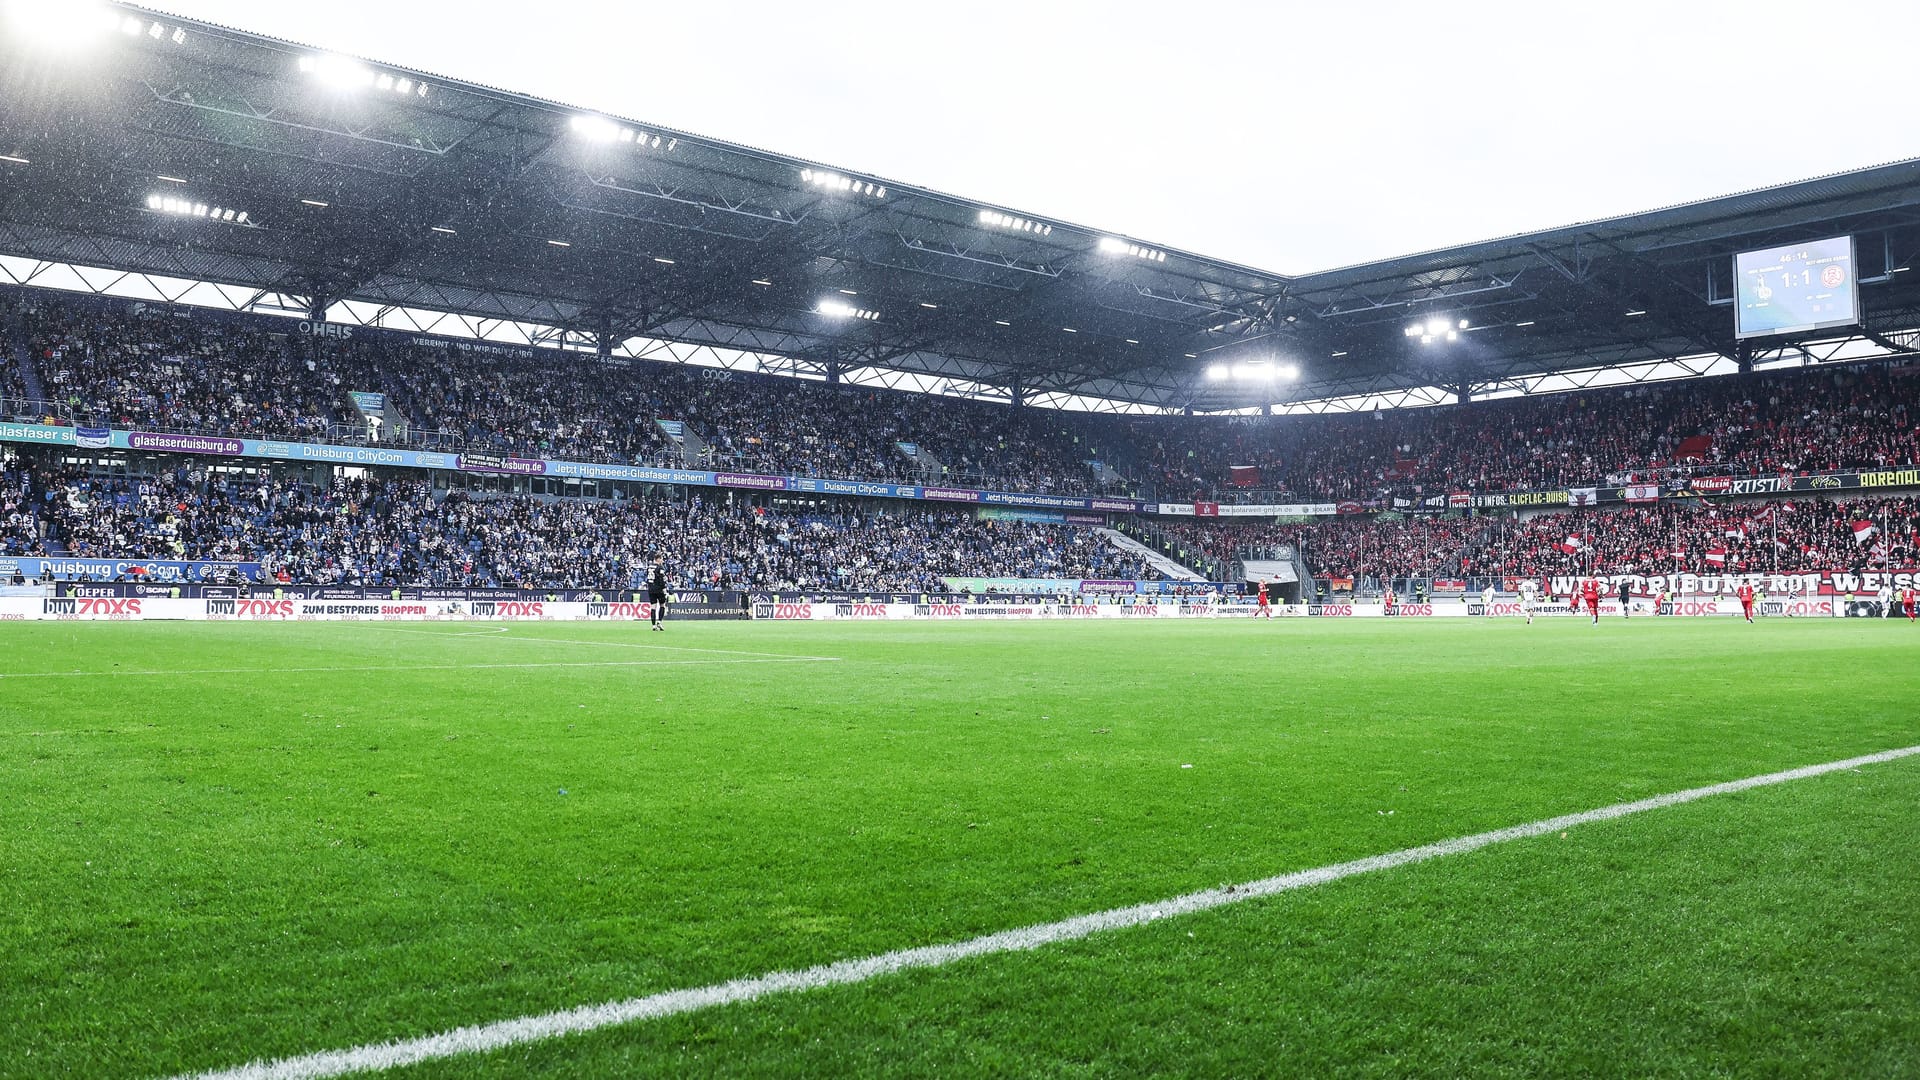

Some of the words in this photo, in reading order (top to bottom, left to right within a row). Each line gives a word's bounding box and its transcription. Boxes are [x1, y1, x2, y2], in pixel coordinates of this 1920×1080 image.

[1782, 269, 1810, 288] 1:1
[313, 323, 353, 339] HEIS
[412, 337, 449, 349] VEREINT
[0, 426, 57, 440] lasfaser
[134, 435, 238, 452] glasfaserduisburg.de
[303, 446, 354, 461] Duisburg
[357, 448, 402, 463] CityCom
[555, 464, 577, 475] Jetzt
[580, 466, 670, 480] Highspeed-Glasfaser
[673, 471, 706, 482] sichern!
[717, 475, 783, 488] glasfaserduisburg.de
[824, 482, 856, 493] Duisburg
[858, 485, 888, 495] CityCom
[986, 493, 1000, 501] Jetzt
[1002, 494, 1062, 505] Highspeed-Glasfaser
[1394, 498, 1411, 507] WILD
[1426, 495, 1445, 507] BOYS
[1477, 497, 1482, 507] &
[1509, 491, 1568, 505] FLICFLAC-DUISB
[40, 561, 110, 577] Duisburg
[45, 600, 74, 614] buy
[78, 599, 141, 614] ZOXS
[207, 600, 235, 614] buy
[237, 600, 293, 616] ZOXS
[303, 605, 326, 615] ZUM
[327, 605, 379, 615] BESTPREIS
[381, 605, 427, 615] SHOPPEN
[472, 602, 495, 616] buy
[497, 602, 543, 616] ZOXS
[588, 603, 608, 617] buy
[610, 603, 650, 619] ZOXS
[757, 604, 773, 618] buy
[775, 604, 811, 619] ZOXS
[1309, 606, 1322, 616] buy
[1323, 605, 1352, 616] ZOXS
[1401, 605, 1433, 616] ZOXS
[1468, 604, 1484, 615] buy
[1660, 603, 1673, 615] uy
[1674, 602, 1717, 616] ZOXS
[1762, 603, 1782, 614] buy
